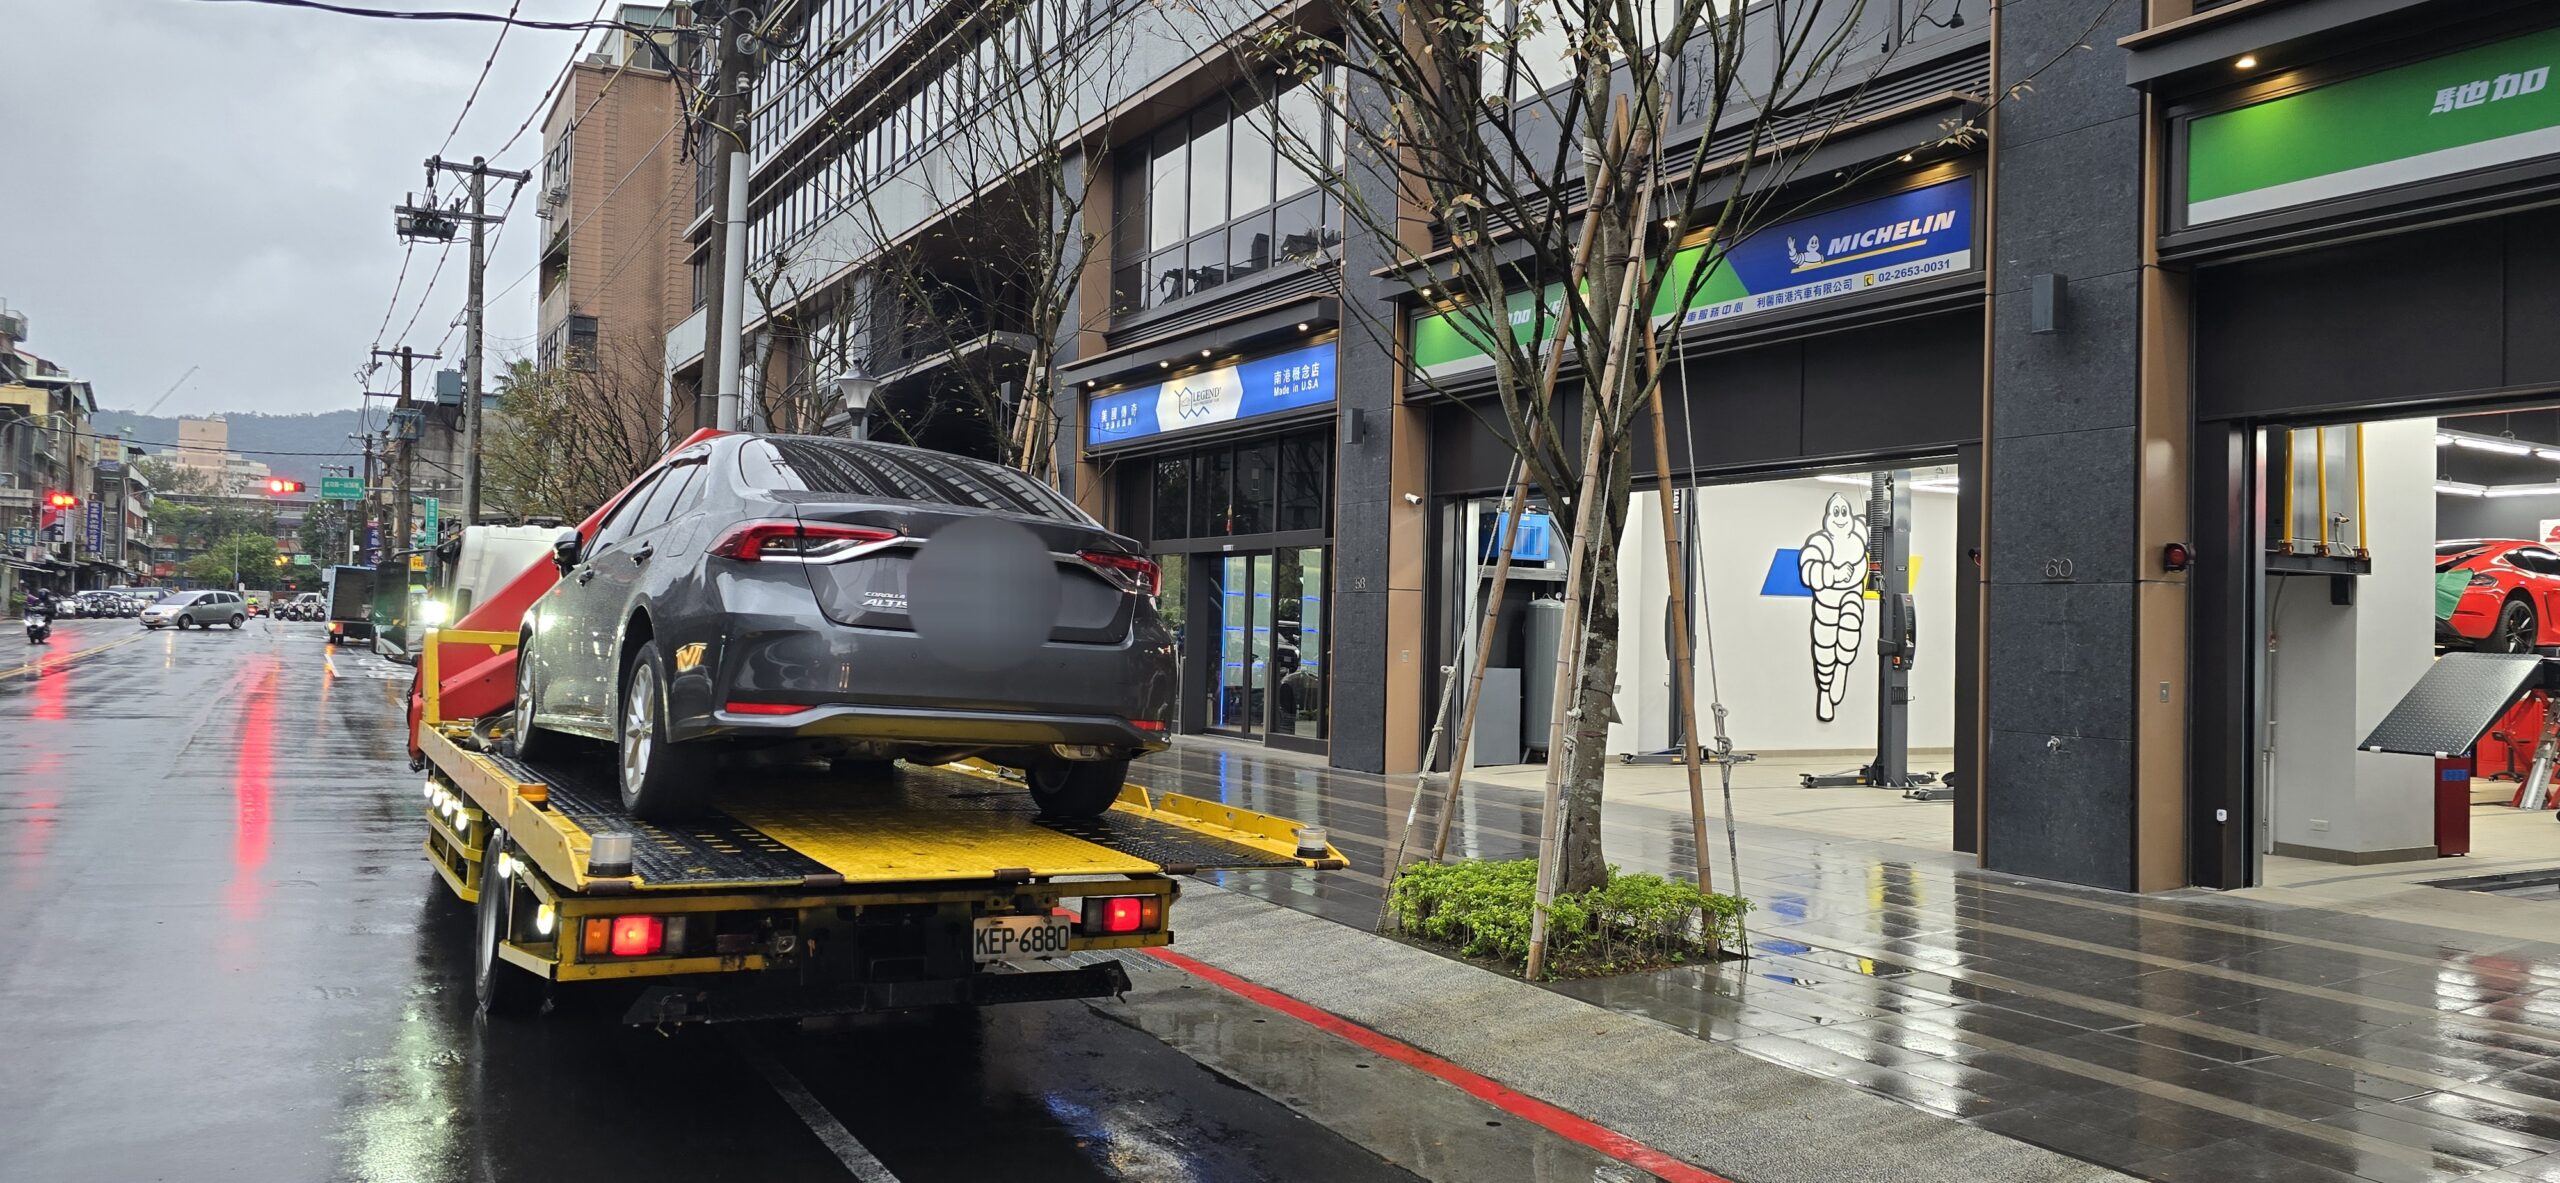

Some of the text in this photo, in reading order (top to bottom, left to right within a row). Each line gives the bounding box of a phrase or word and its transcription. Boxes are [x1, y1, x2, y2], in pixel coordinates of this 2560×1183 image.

[2428, 66, 2550, 116] 馳加
[1827, 210, 1956, 256] MICHELIN
[1878, 259, 1950, 283] 02-2653-0031
[1508, 308, 1532, 326] 加
[1686, 301, 1744, 322] 車服務中心
[1273, 361, 1320, 386] 南港概念店
[1193, 387, 1220, 402] LEGEND
[1273, 385, 1290, 397] Made
[1292, 383, 1299, 393] in
[2045, 558, 2073, 577] 60
[861, 598, 908, 609] ALTIS
[975, 925, 1069, 955] KEP-6880
